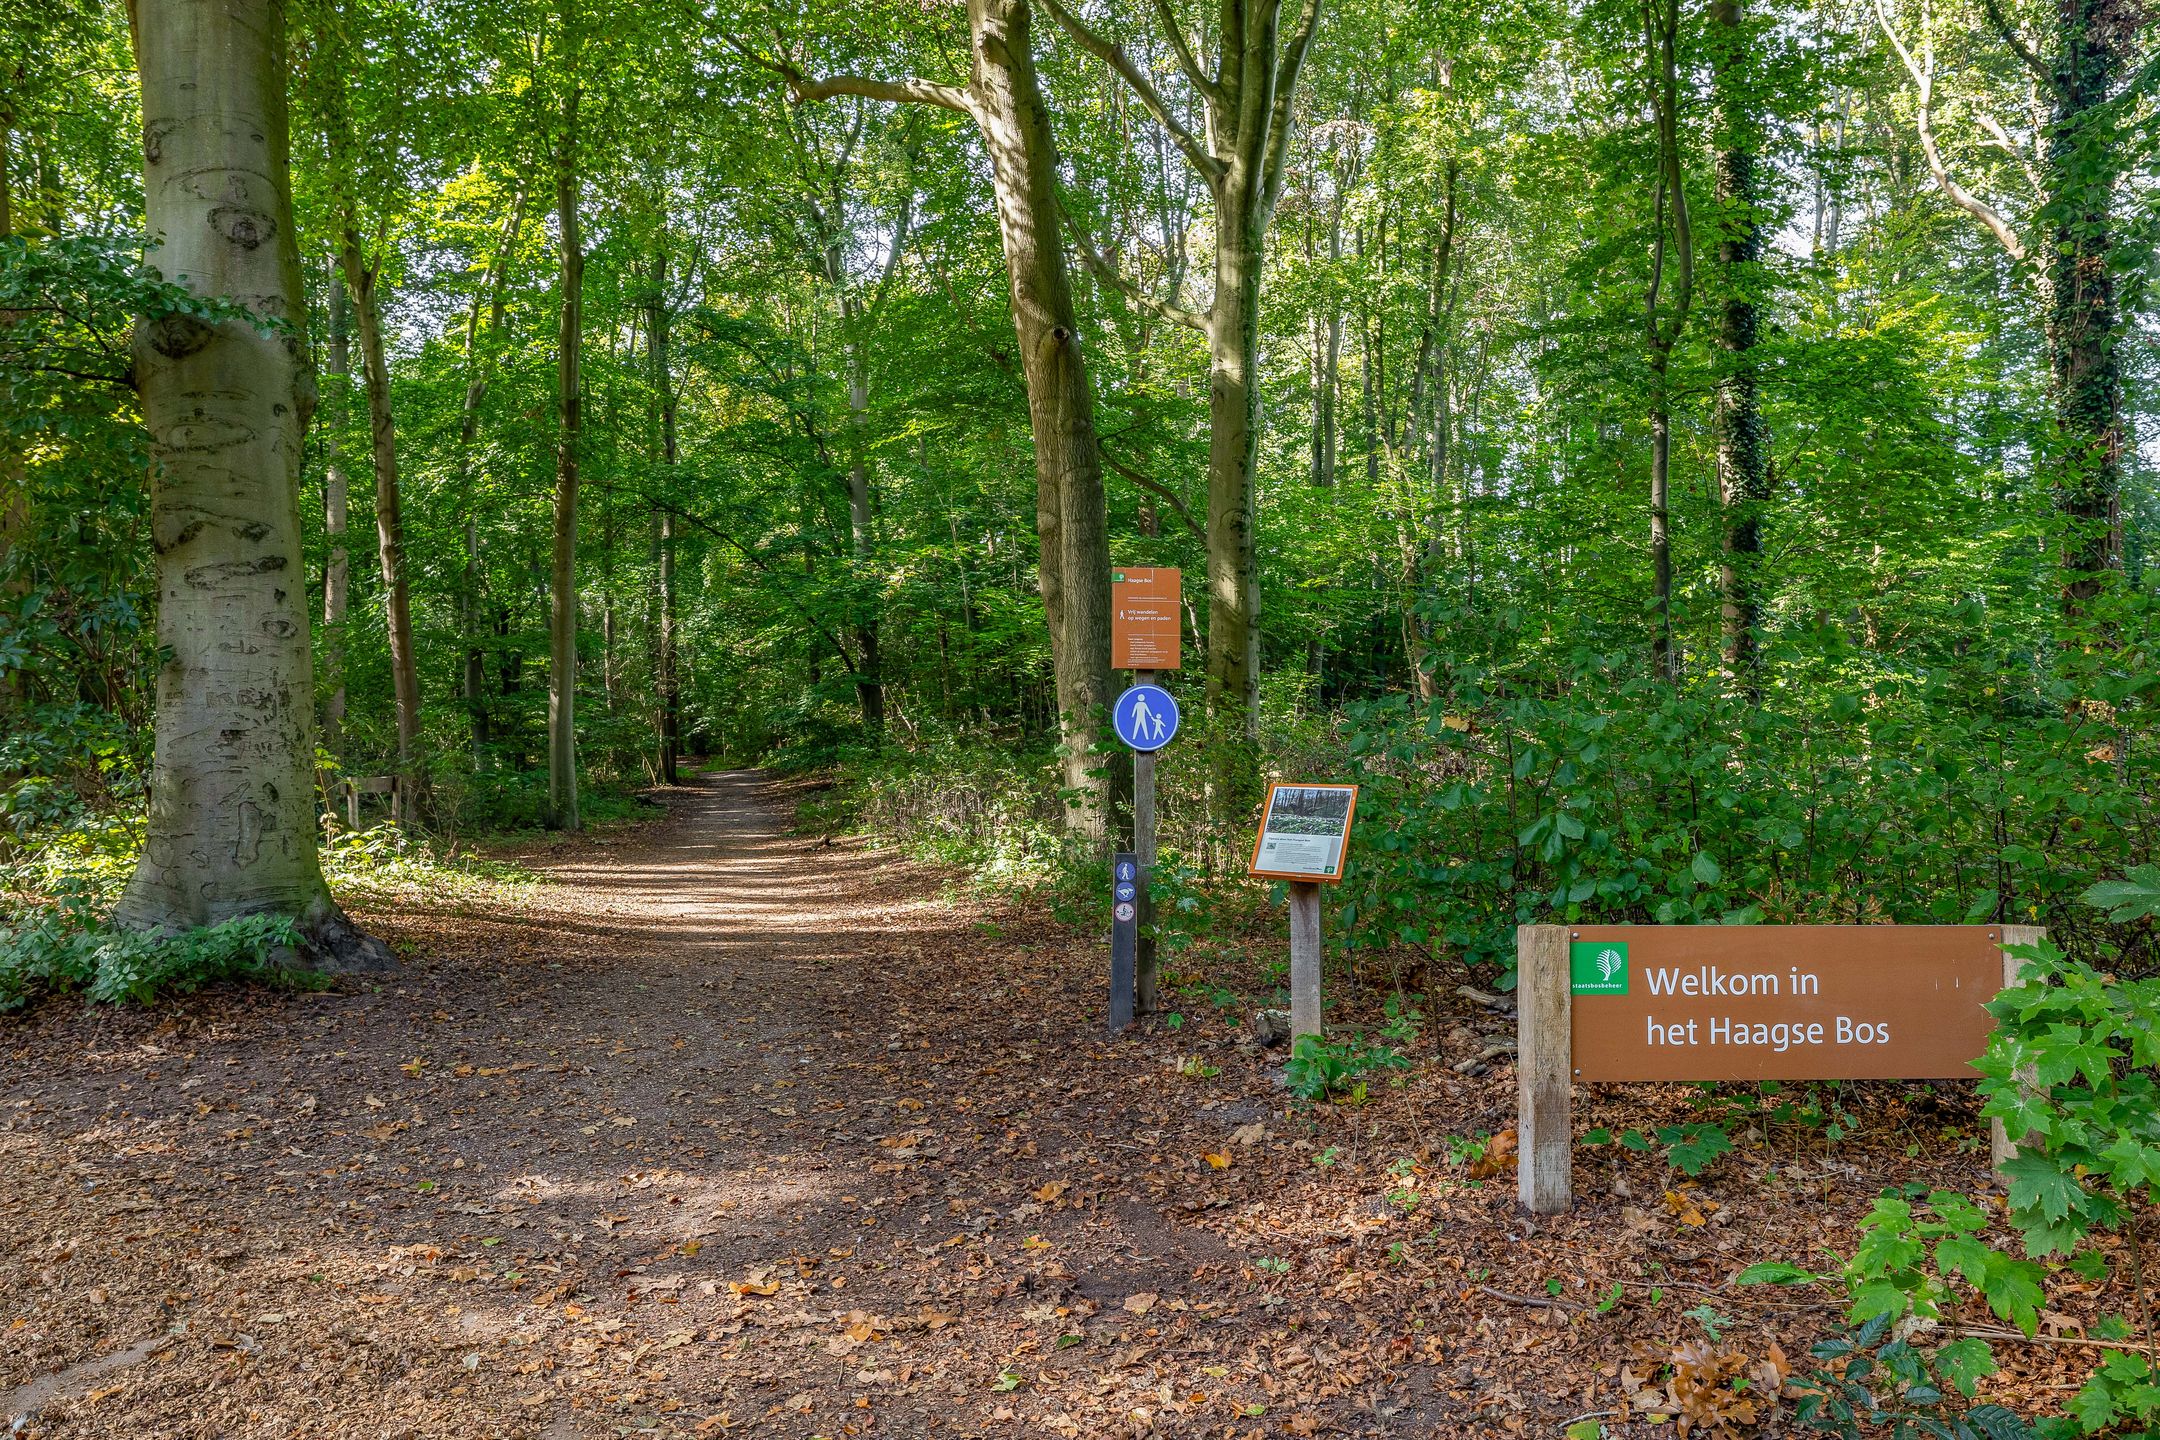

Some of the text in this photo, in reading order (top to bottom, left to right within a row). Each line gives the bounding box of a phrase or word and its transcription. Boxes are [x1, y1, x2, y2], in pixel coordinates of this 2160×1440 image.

[1646, 966, 1817, 995] Welkom in
[1648, 1016, 1890, 1051] het Haagse Bos
